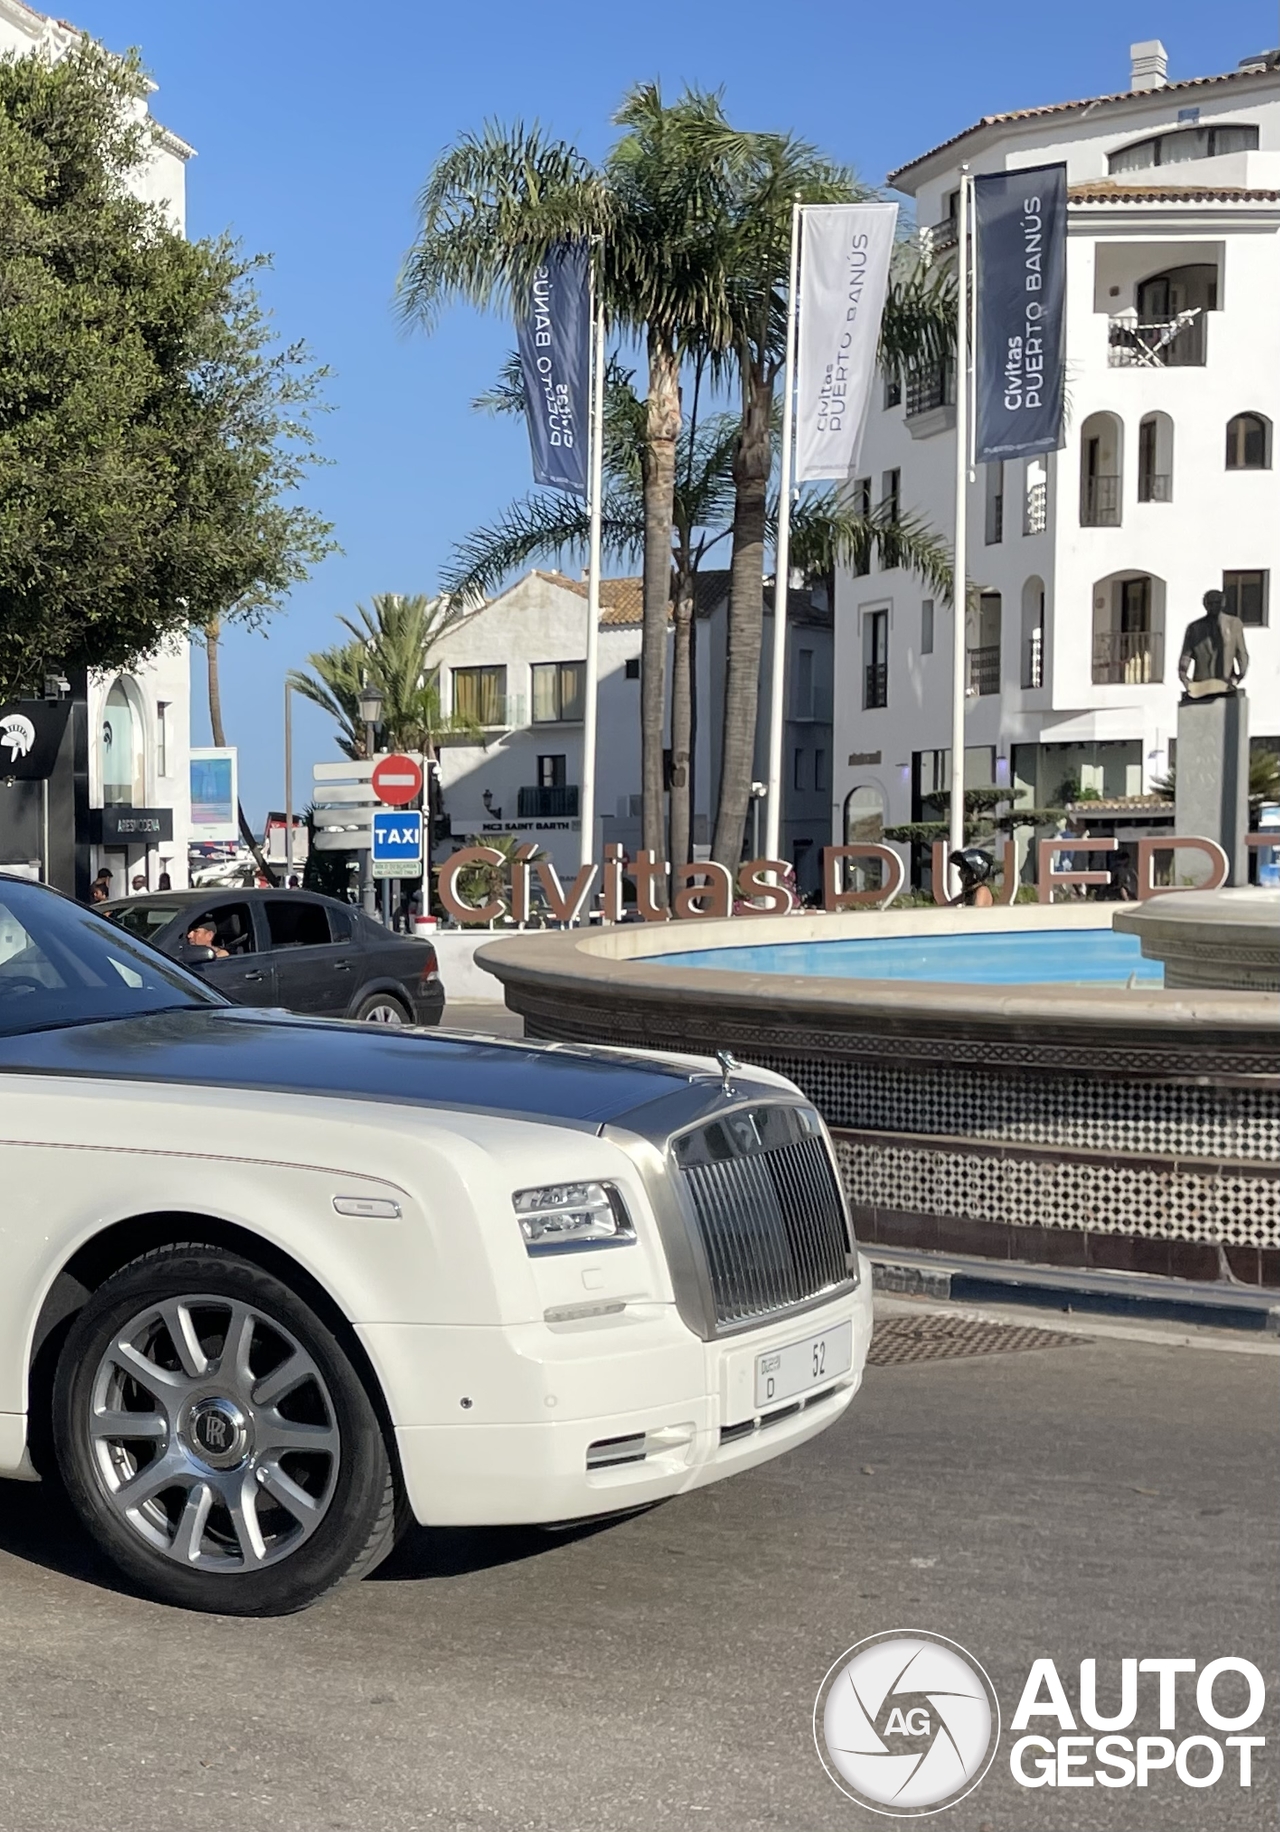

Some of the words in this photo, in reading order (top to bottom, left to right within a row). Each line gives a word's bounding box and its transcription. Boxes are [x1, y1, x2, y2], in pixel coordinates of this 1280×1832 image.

[1020, 196, 1042, 291] BANÚS
[830, 332, 852, 431] PUERTO
[1005, 335, 1023, 411] Cívitas
[1025, 301, 1044, 409] PUERTO
[375, 828, 419, 844] TAXI
[505, 822, 534, 830] SAINT
[536, 822, 569, 830] BARTH
[438, 842, 793, 922] Cívitas
[813, 1341, 826, 1377] 52
